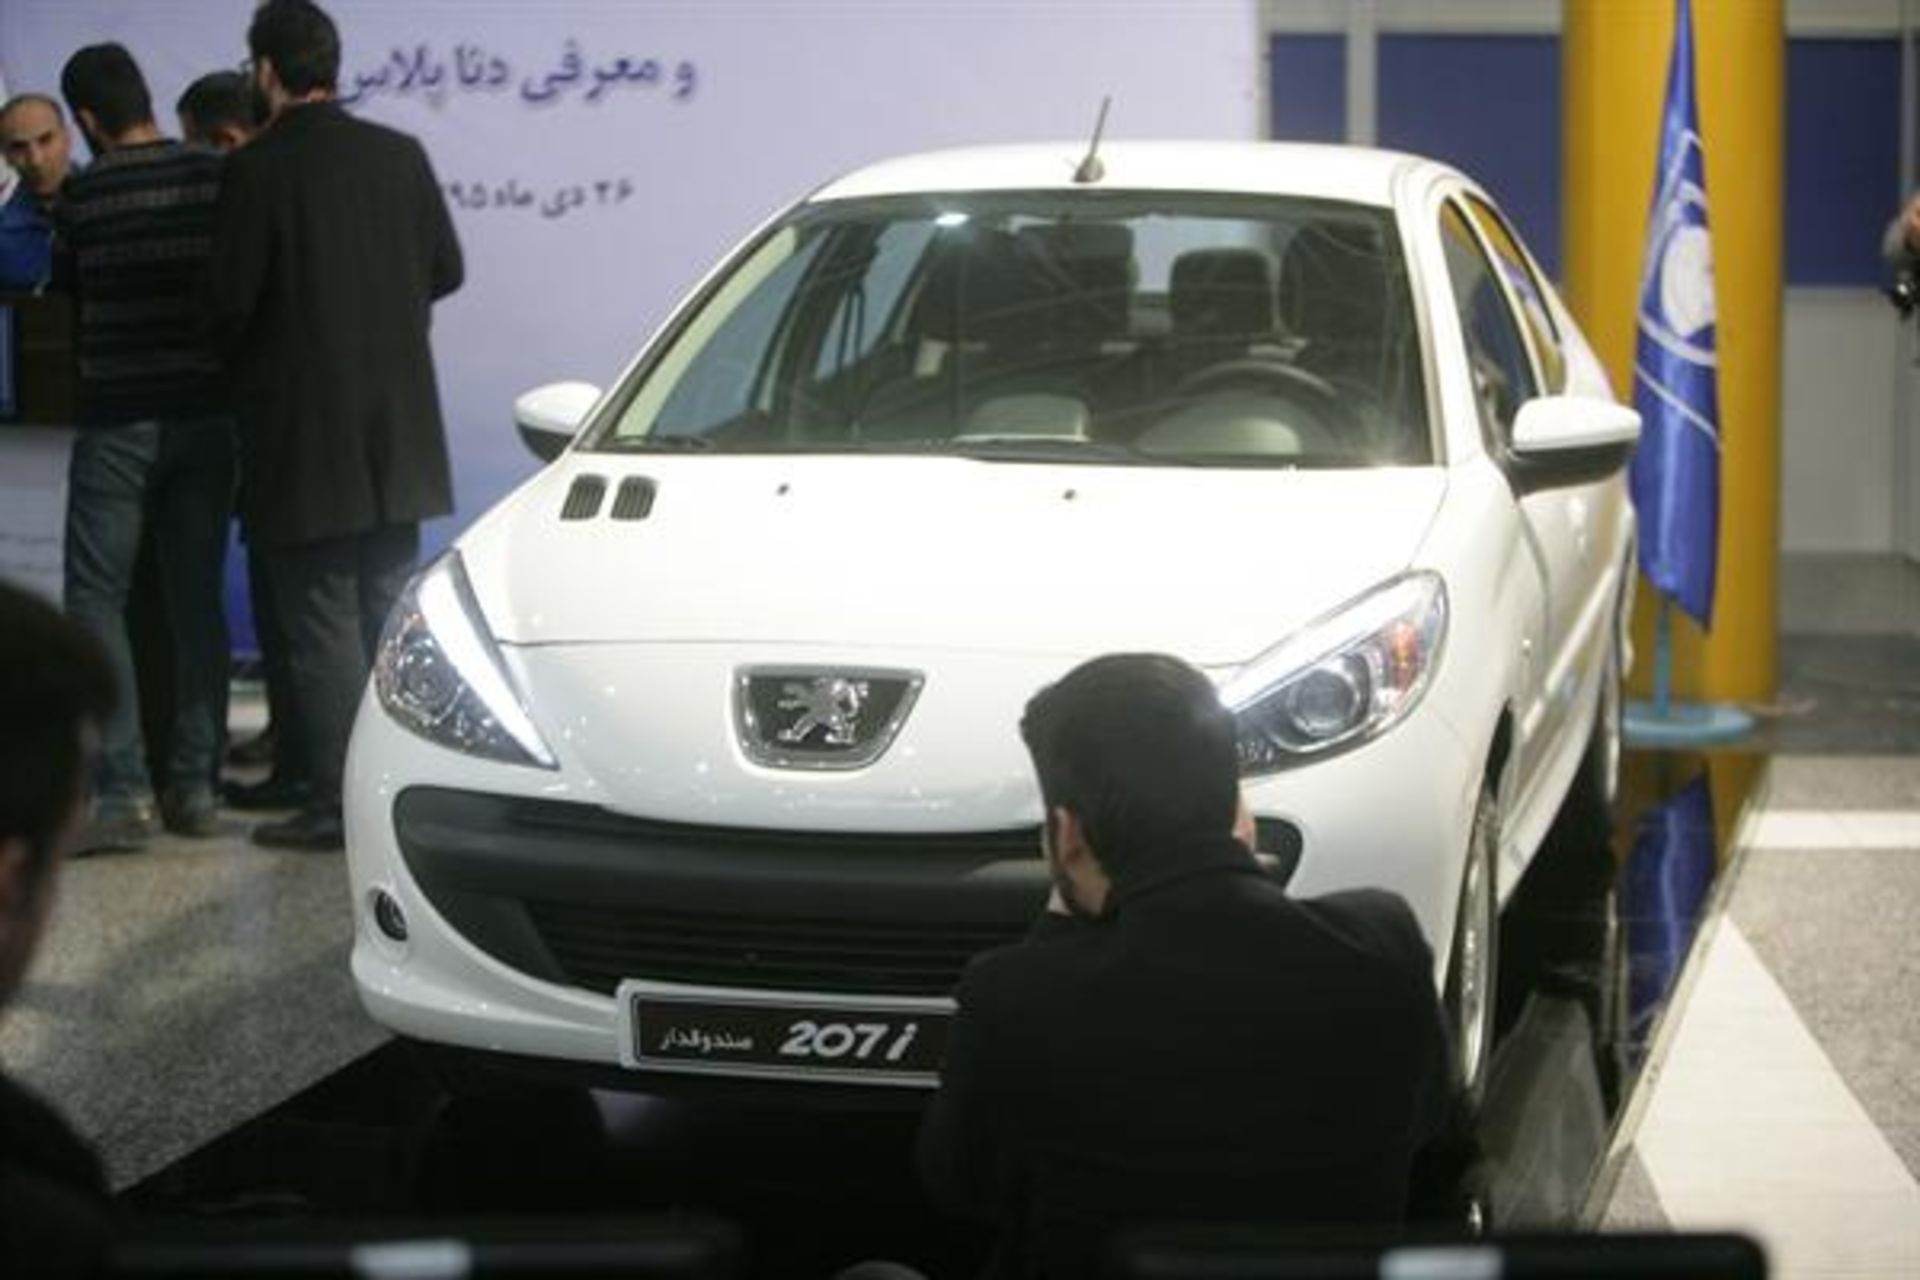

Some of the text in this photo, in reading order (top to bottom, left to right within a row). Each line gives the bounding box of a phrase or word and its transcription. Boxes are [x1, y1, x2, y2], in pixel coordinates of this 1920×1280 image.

[340, 38, 696, 112] و معرفی دنا پلاس
[445, 179, 487, 210] ۹۵
[495, 179, 534, 209] ماه
[541, 186, 586, 219] دی
[659, 1026, 754, 1055] صندوقدار
